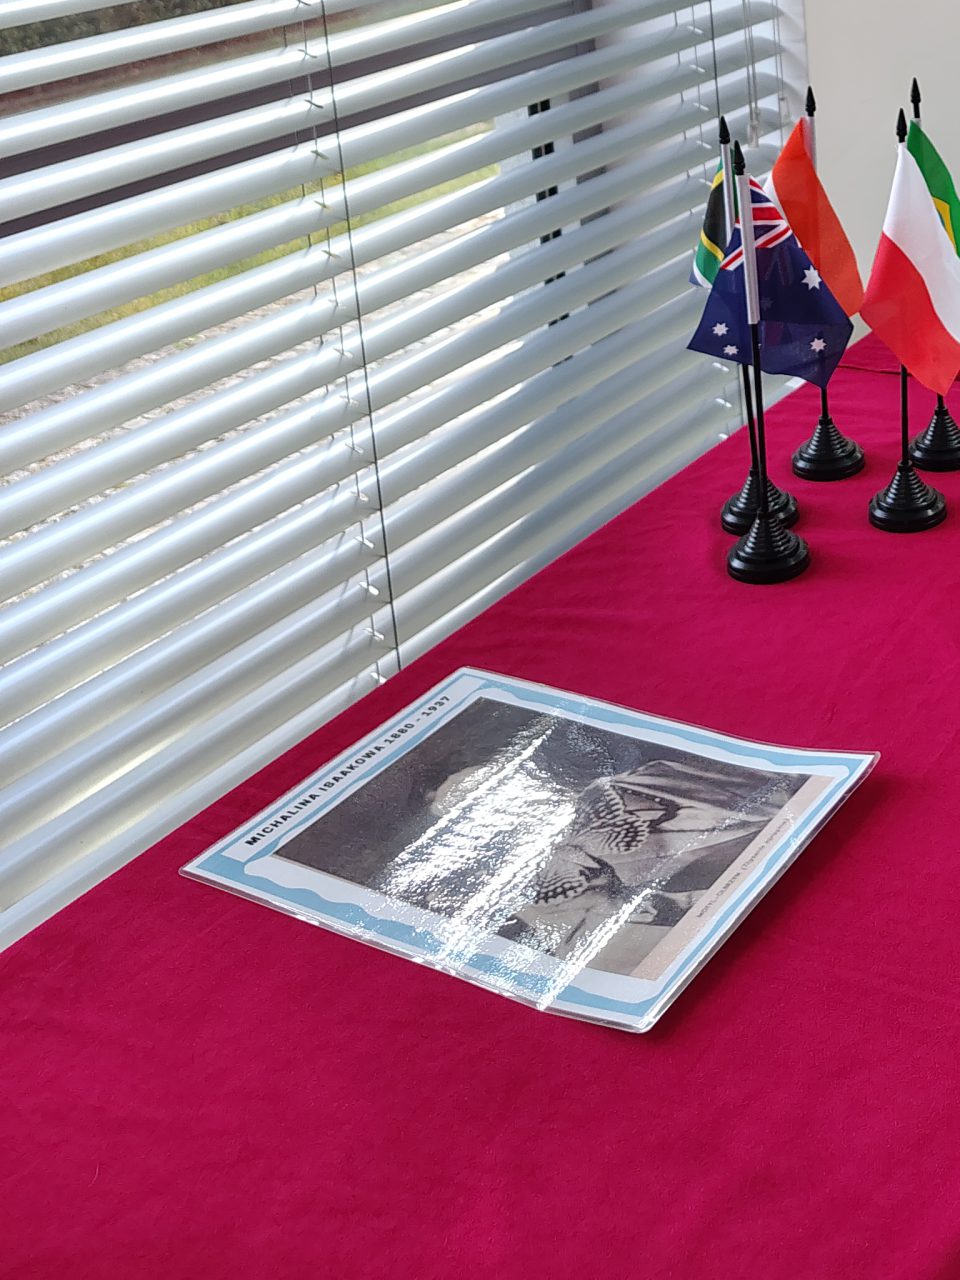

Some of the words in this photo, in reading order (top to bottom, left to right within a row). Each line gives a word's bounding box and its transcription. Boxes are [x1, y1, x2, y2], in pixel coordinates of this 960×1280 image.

[244, 792, 320, 846] MICHALINA
[384, 722, 415, 745] 1880
[421, 695, 451, 717] 1937
